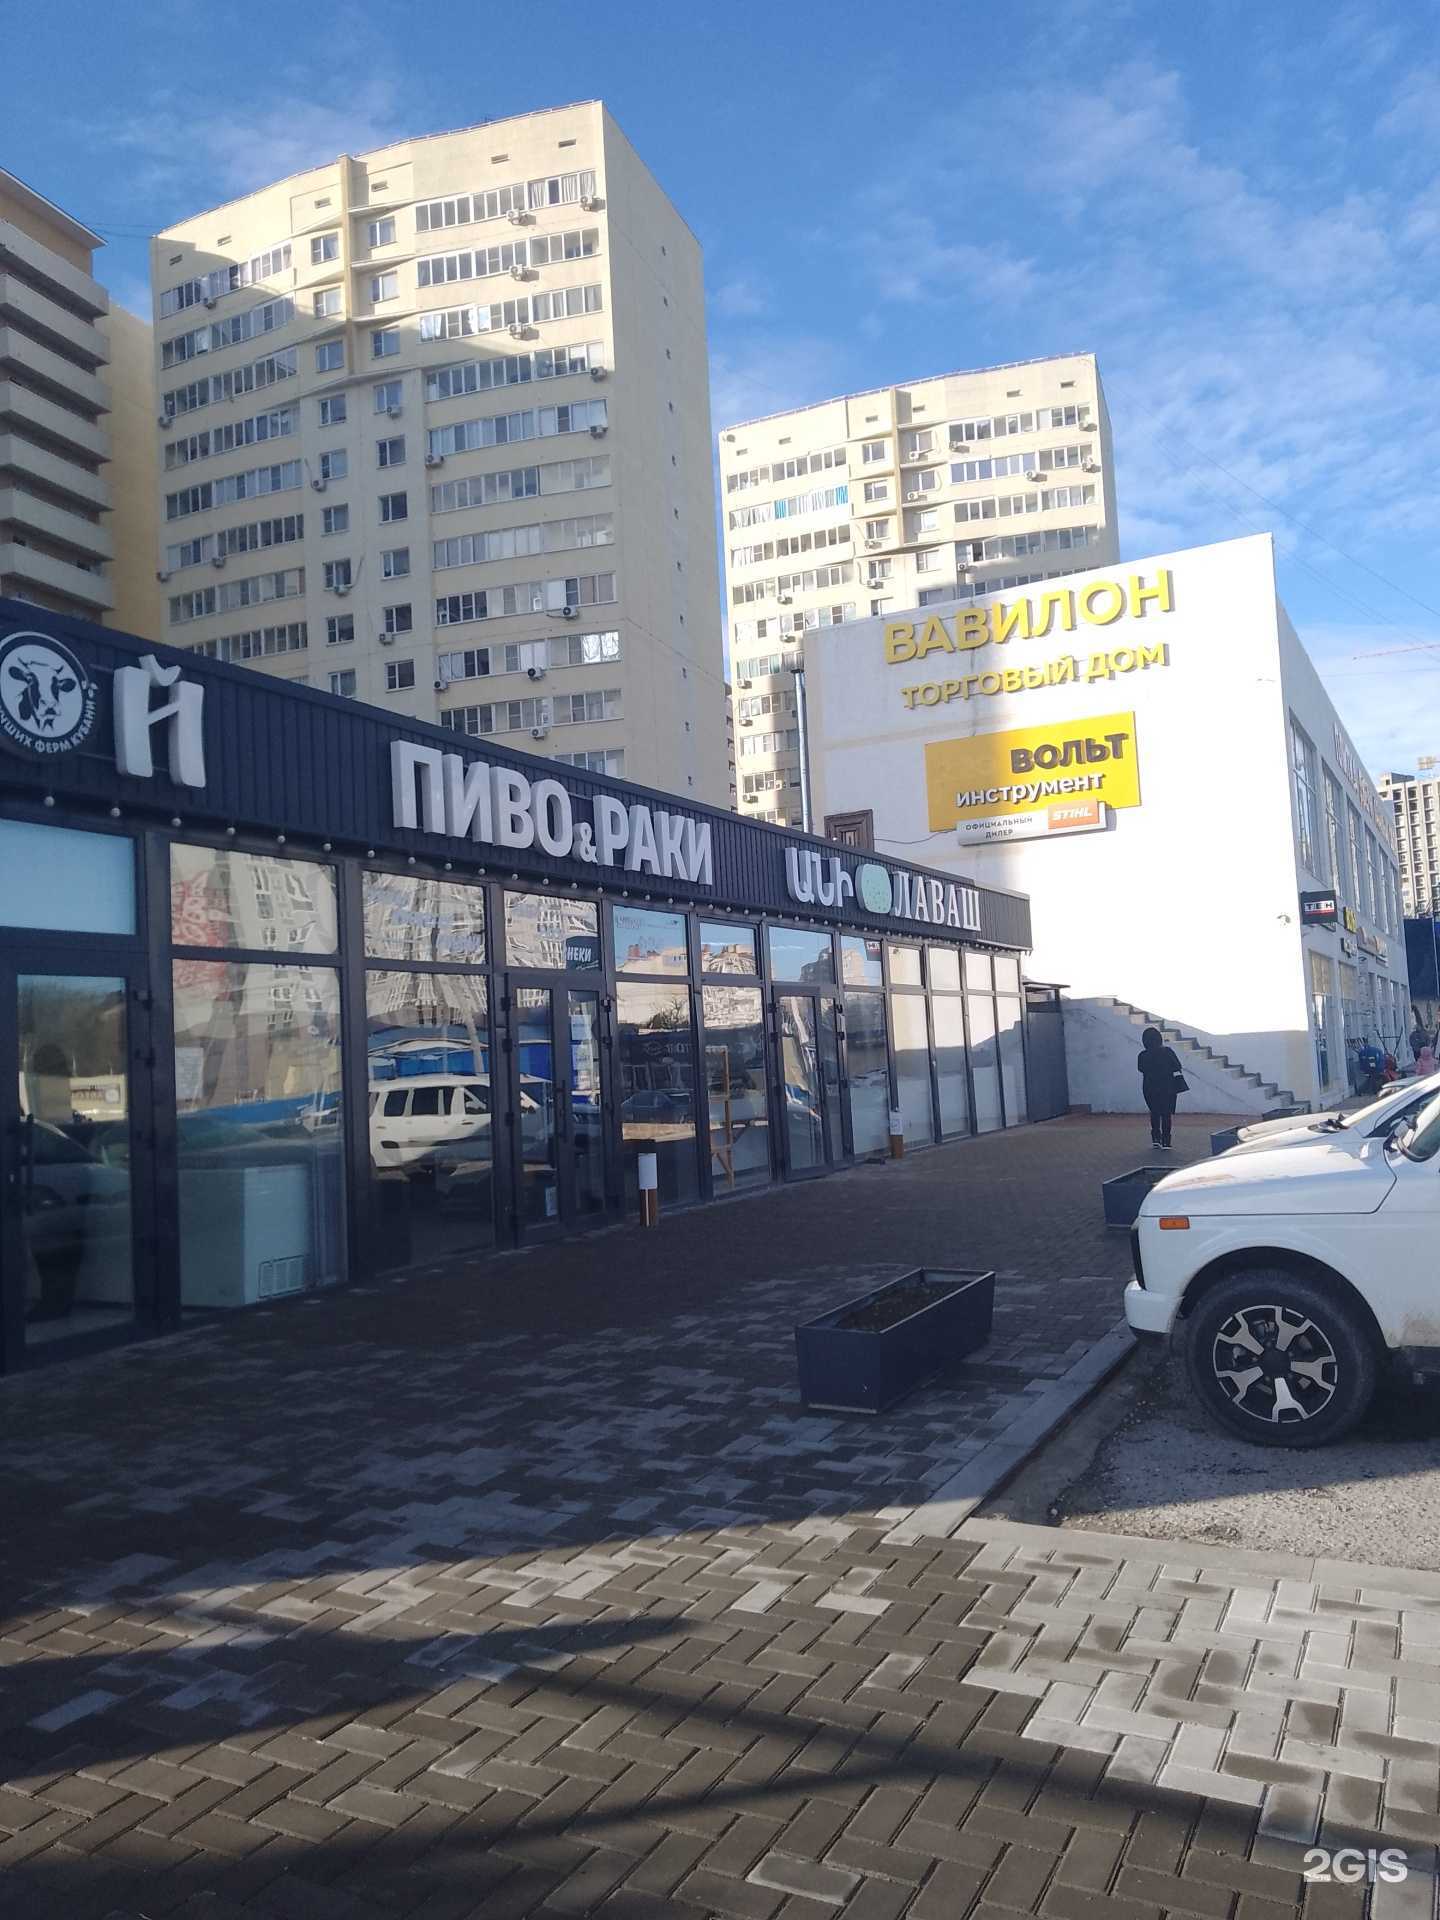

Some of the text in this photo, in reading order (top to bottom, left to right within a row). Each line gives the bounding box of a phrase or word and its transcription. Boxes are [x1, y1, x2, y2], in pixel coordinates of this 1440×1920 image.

[884, 569, 1172, 664] ВАВИЛОН
[902, 643, 1170, 709] ТОРГОВЫЙ ДОМ
[34, 739, 72, 753] ФЕРМ
[69, 699, 96, 747] КУБАНИ
[113, 654, 206, 788] Й
[1010, 733, 1129, 774] ВОЛЬТ
[391, 740, 713, 885] ПИВО & РАКИ
[956, 772, 1106, 807] инструмент
[1052, 807, 1093, 821] STIHL
[985, 829, 1014, 839] ДИЛЕР
[892, 870, 981, 931] ЛАВАШ
